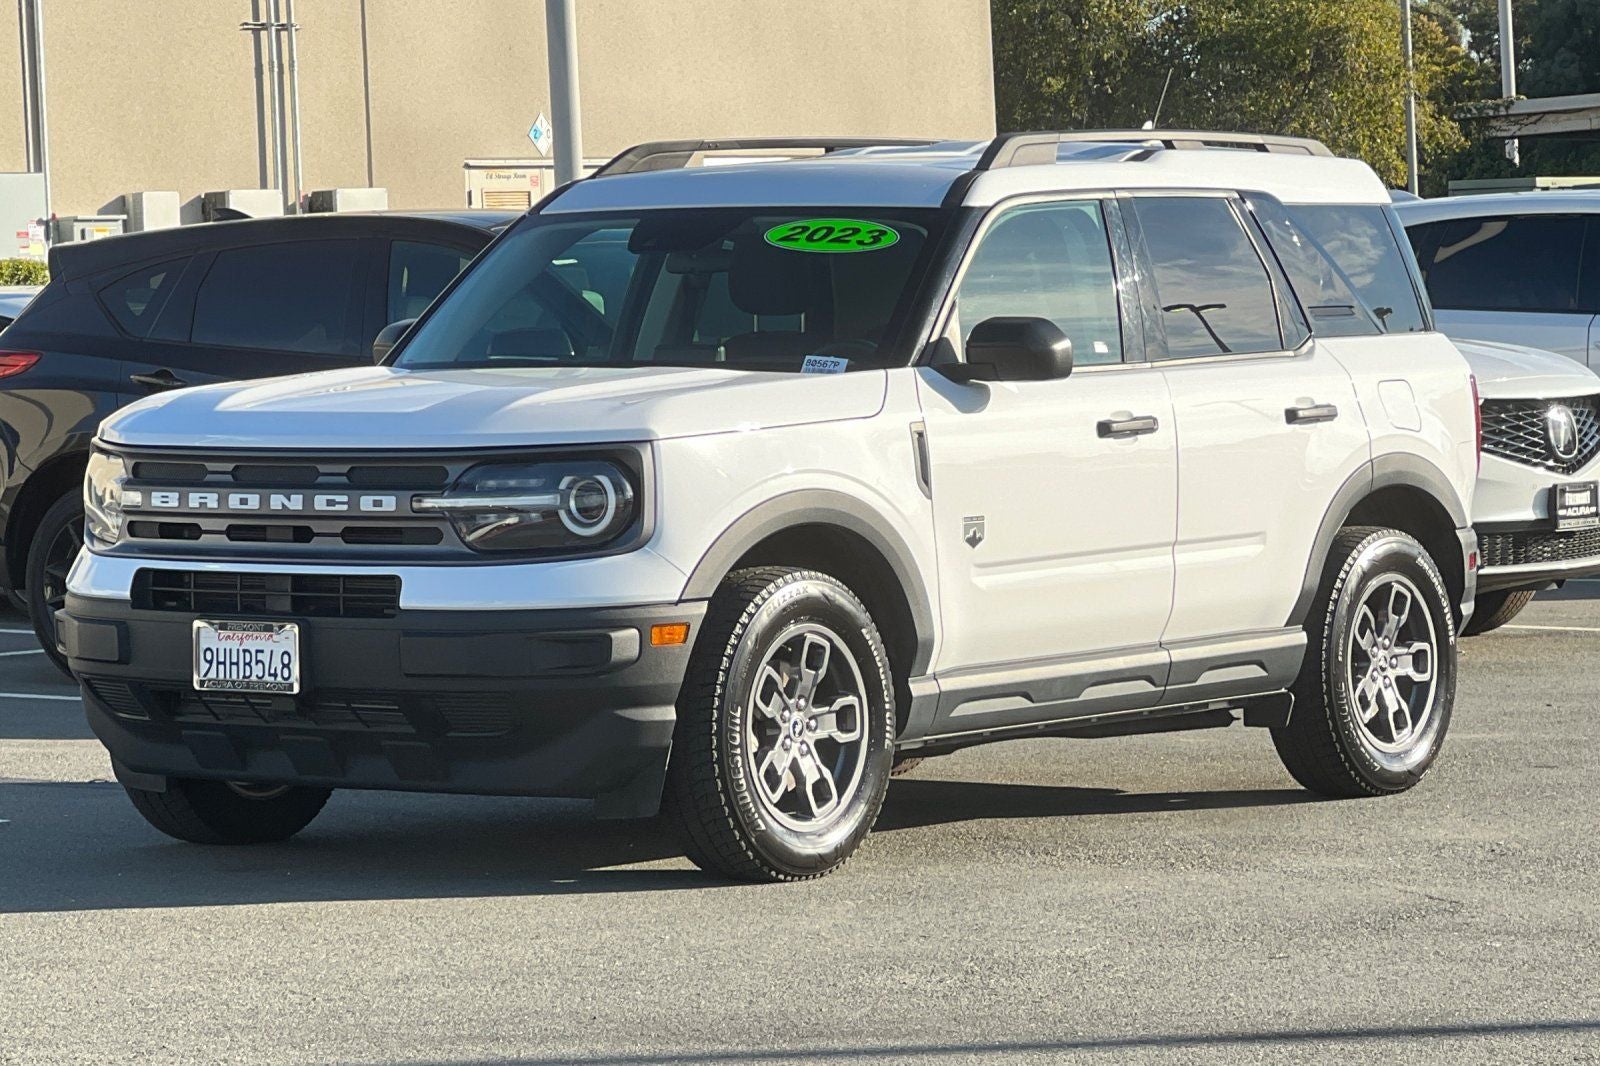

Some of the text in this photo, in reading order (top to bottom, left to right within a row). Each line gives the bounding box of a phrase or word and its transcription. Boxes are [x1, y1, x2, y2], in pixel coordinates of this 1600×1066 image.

[533, 129, 538, 139] 2
[776, 225, 888, 246] 2023
[151, 491, 396, 511] BRONCO
[227, 623, 264, 631] FREMONT
[218, 633, 274, 646] California
[203, 647, 292, 681] 9HHB548
[203, 680, 234, 688] ACURA
[249, 682, 290, 691] FREMONT
